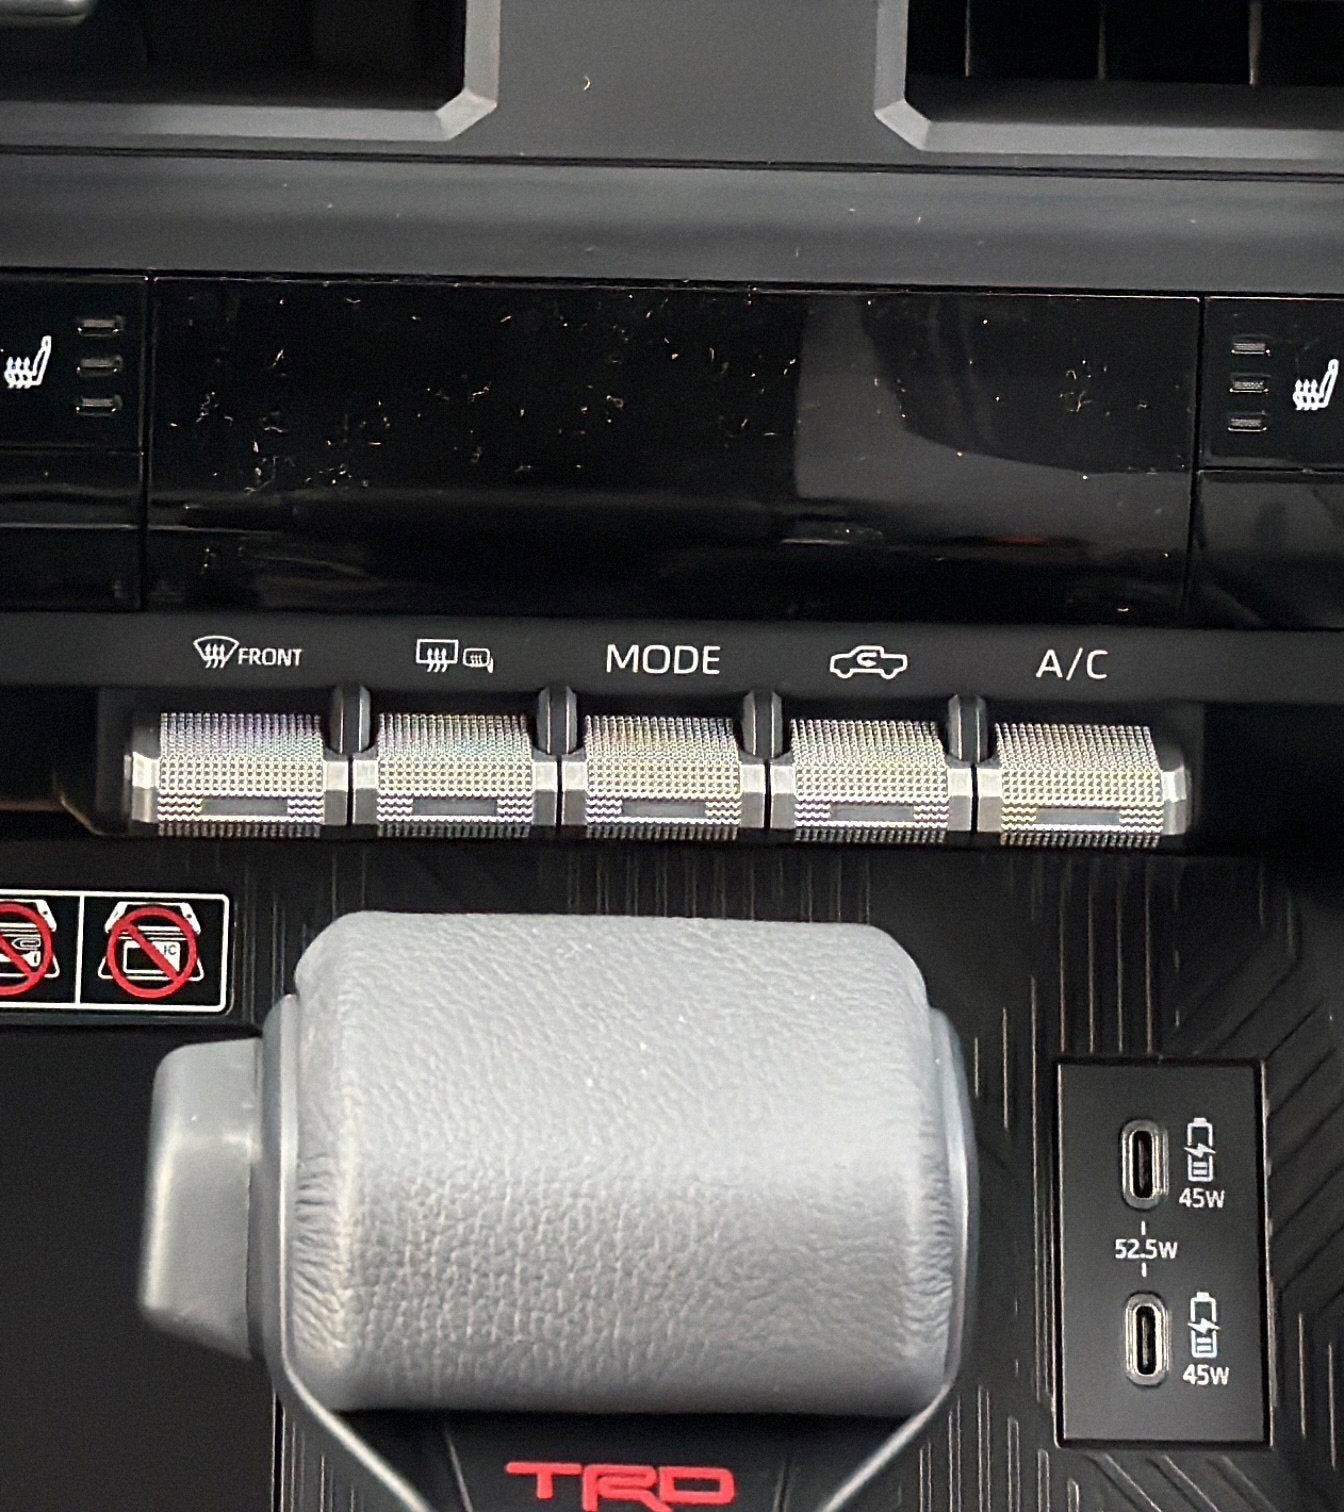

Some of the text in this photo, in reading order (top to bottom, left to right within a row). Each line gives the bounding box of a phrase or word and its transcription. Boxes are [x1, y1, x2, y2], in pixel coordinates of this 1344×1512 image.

[238, 646, 303, 668] FRONT
[606, 644, 721, 675] MODE
[1037, 647, 1109, 681] A/C
[1178, 1188, 1225, 1208] 45W
[1115, 1239, 1178, 1260] 52.5W
[1182, 1364, 1229, 1386] 45W
[506, 1462, 735, 1512] TRD
